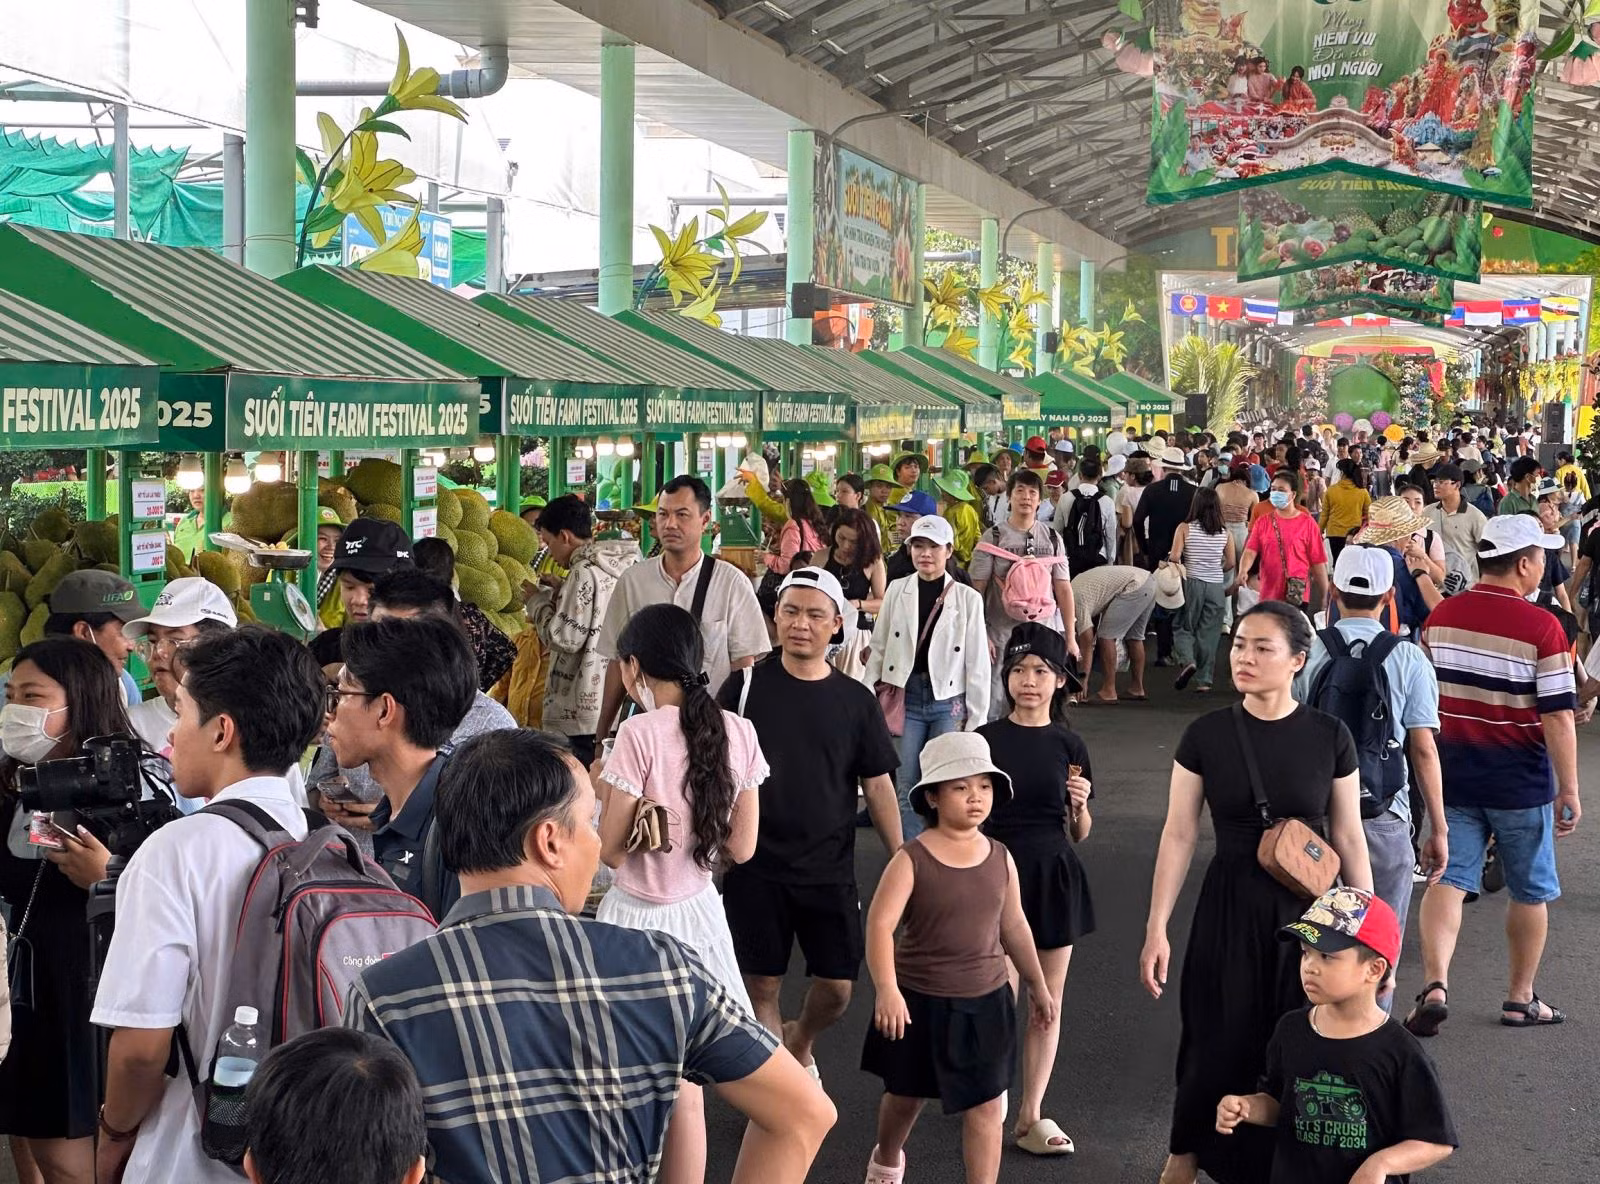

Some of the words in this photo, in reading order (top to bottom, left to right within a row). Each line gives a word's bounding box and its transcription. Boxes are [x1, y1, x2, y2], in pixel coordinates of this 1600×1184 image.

[1352, 31, 1377, 46] VUI
[1307, 62, 1336, 81] MỌI
[3, 387, 96, 433] FESTIVAL
[100, 387, 141, 430] 2025
[157, 400, 213, 428] 025
[244, 386, 286, 437] SUỐI
[289, 391, 325, 437] TIÊN
[328, 402, 369, 437] FARM
[372, 402, 436, 437] FESTIVAL
[438, 403, 468, 436] 2025
[511, 384, 533, 425] SUỐI
[536, 389, 557, 426] TIÊN
[557, 398, 581, 426] FARM
[583, 398, 620, 426] FESTIVAL
[620, 398, 639, 425] 2025
[646, 389, 666, 424] SUỐI
[667, 393, 686, 424] TIÊN
[686, 400, 706, 424] FARM
[707, 401, 738, 425] FESTIVAL
[739, 401, 754, 425] 2025
[1049, 414, 1070, 422] NAM
[1072, 413, 1085, 423] BỘ
[1088, 415, 1108, 423] 2025
[343, 955, 363, 967] Công
[1325, 1120, 1367, 1137] CRUSH
[1323, 1134, 1337, 1146] OF
[1340, 1136, 1367, 1149] 2034
